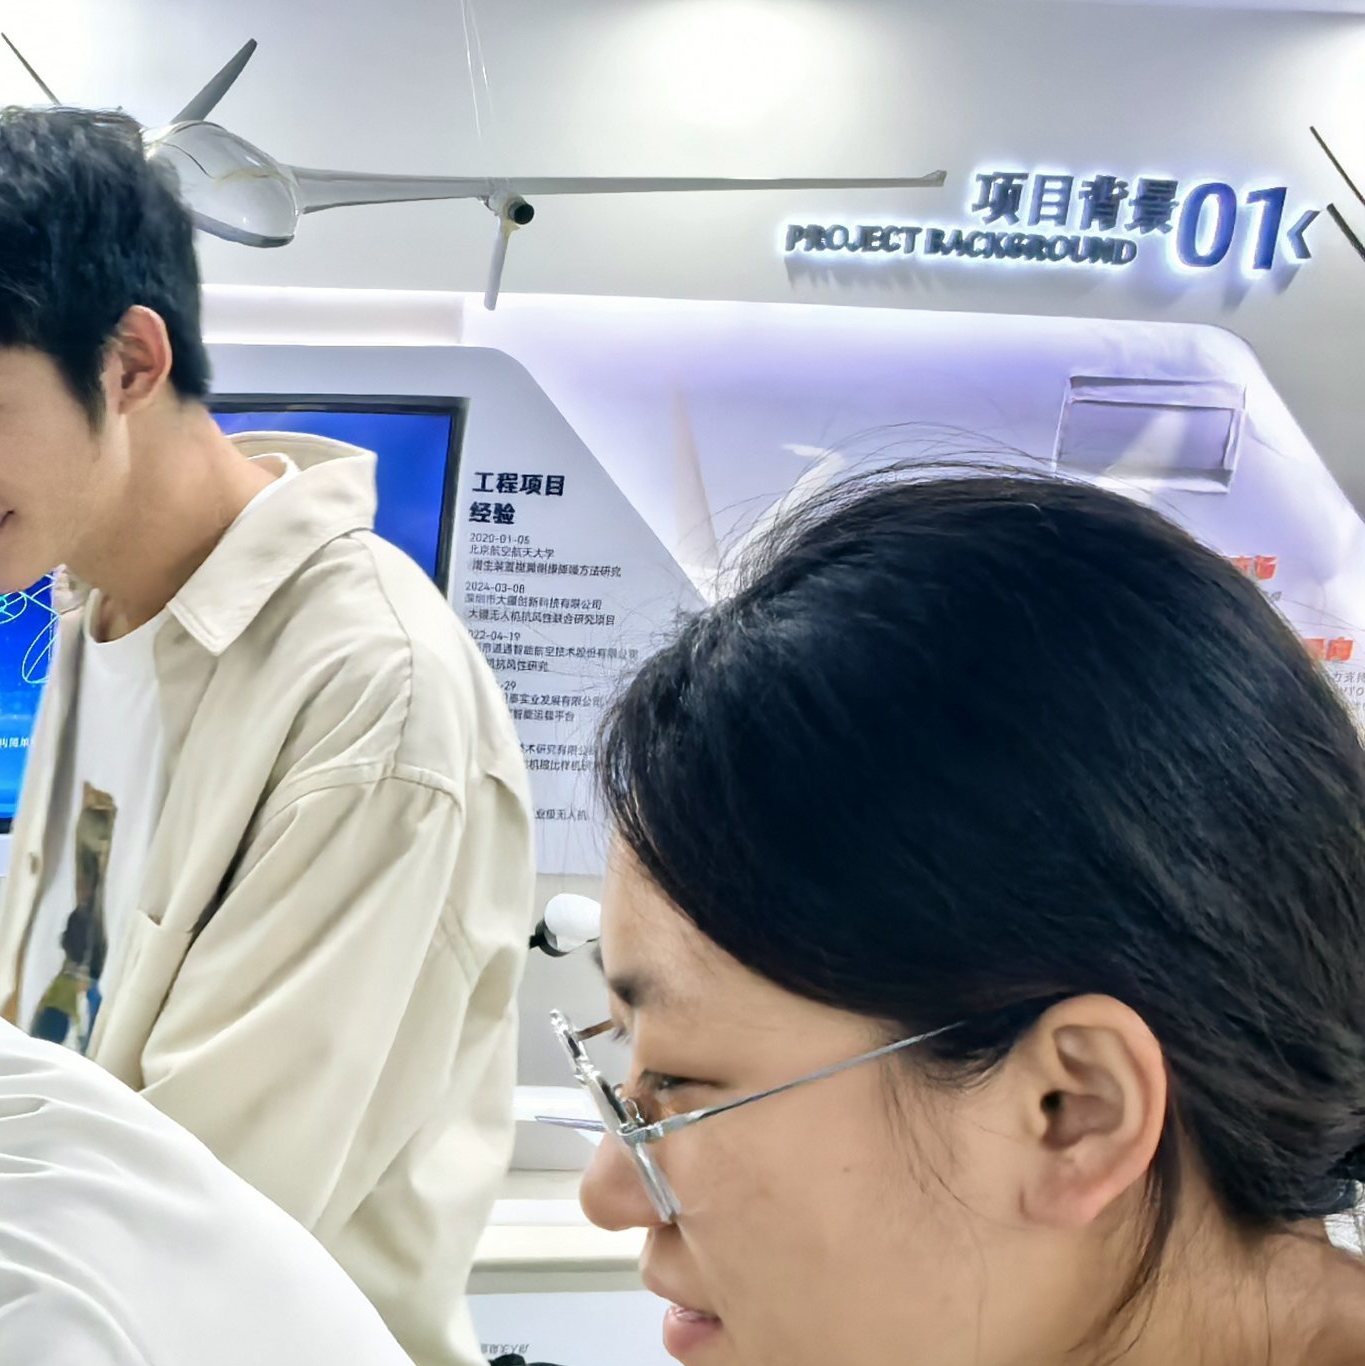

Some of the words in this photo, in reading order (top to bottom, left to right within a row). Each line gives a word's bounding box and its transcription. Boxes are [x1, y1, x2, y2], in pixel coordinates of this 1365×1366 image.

[971, 171, 1181, 235] 项目背景
[1176, 181, 1288, 271] 01
[784, 224, 922, 256] PROJECT
[924, 226, 1138, 266] BACKGROUND
[472, 472, 566, 497] 工程项目
[468, 501, 516, 525] 经验
[469, 544, 555, 560] 北京航空航天大学
